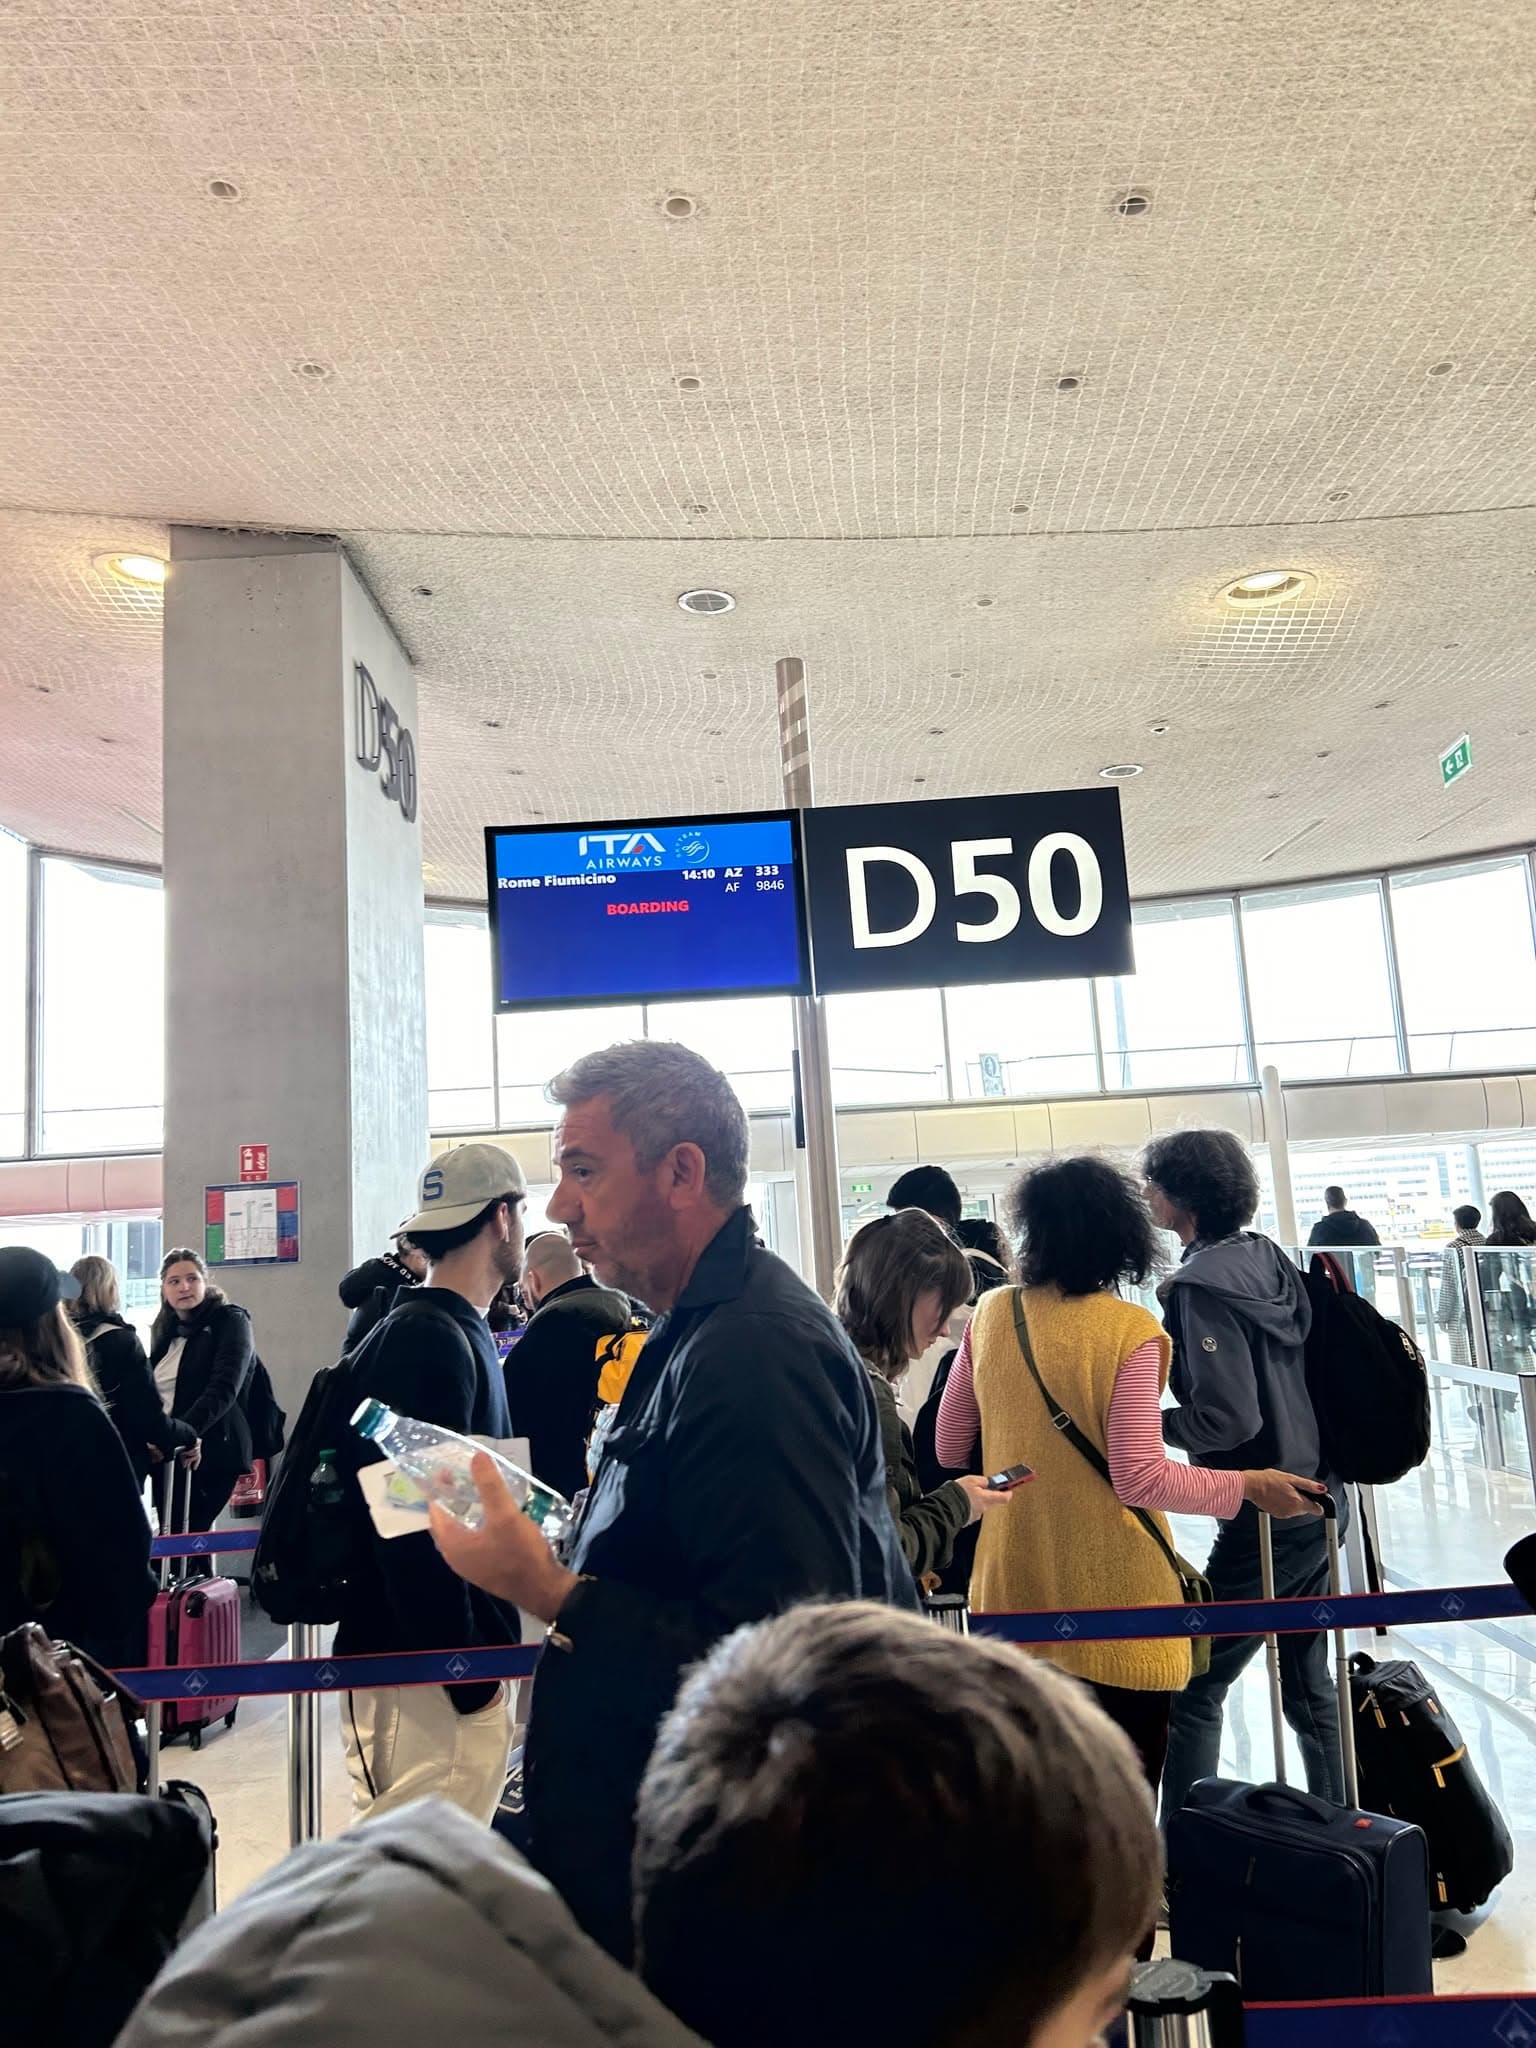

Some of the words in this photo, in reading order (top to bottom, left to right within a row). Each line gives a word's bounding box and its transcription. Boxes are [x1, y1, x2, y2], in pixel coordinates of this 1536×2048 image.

[354, 660, 417, 823] D50
[578, 832, 666, 855] ITA
[585, 855, 663, 870] AIRWAYS
[497, 876, 541, 889] Rome
[544, 873, 617, 887] Fiumicino
[682, 868, 716, 880] 14:10
[724, 867, 744, 878] AZ
[755, 865, 780, 876] 333
[725, 882, 741, 893] AF
[755, 879, 785, 891] 9846
[845, 831, 1103, 949] D50
[606, 900, 690, 916] BOARDING
[422, 1170, 444, 1201] S
